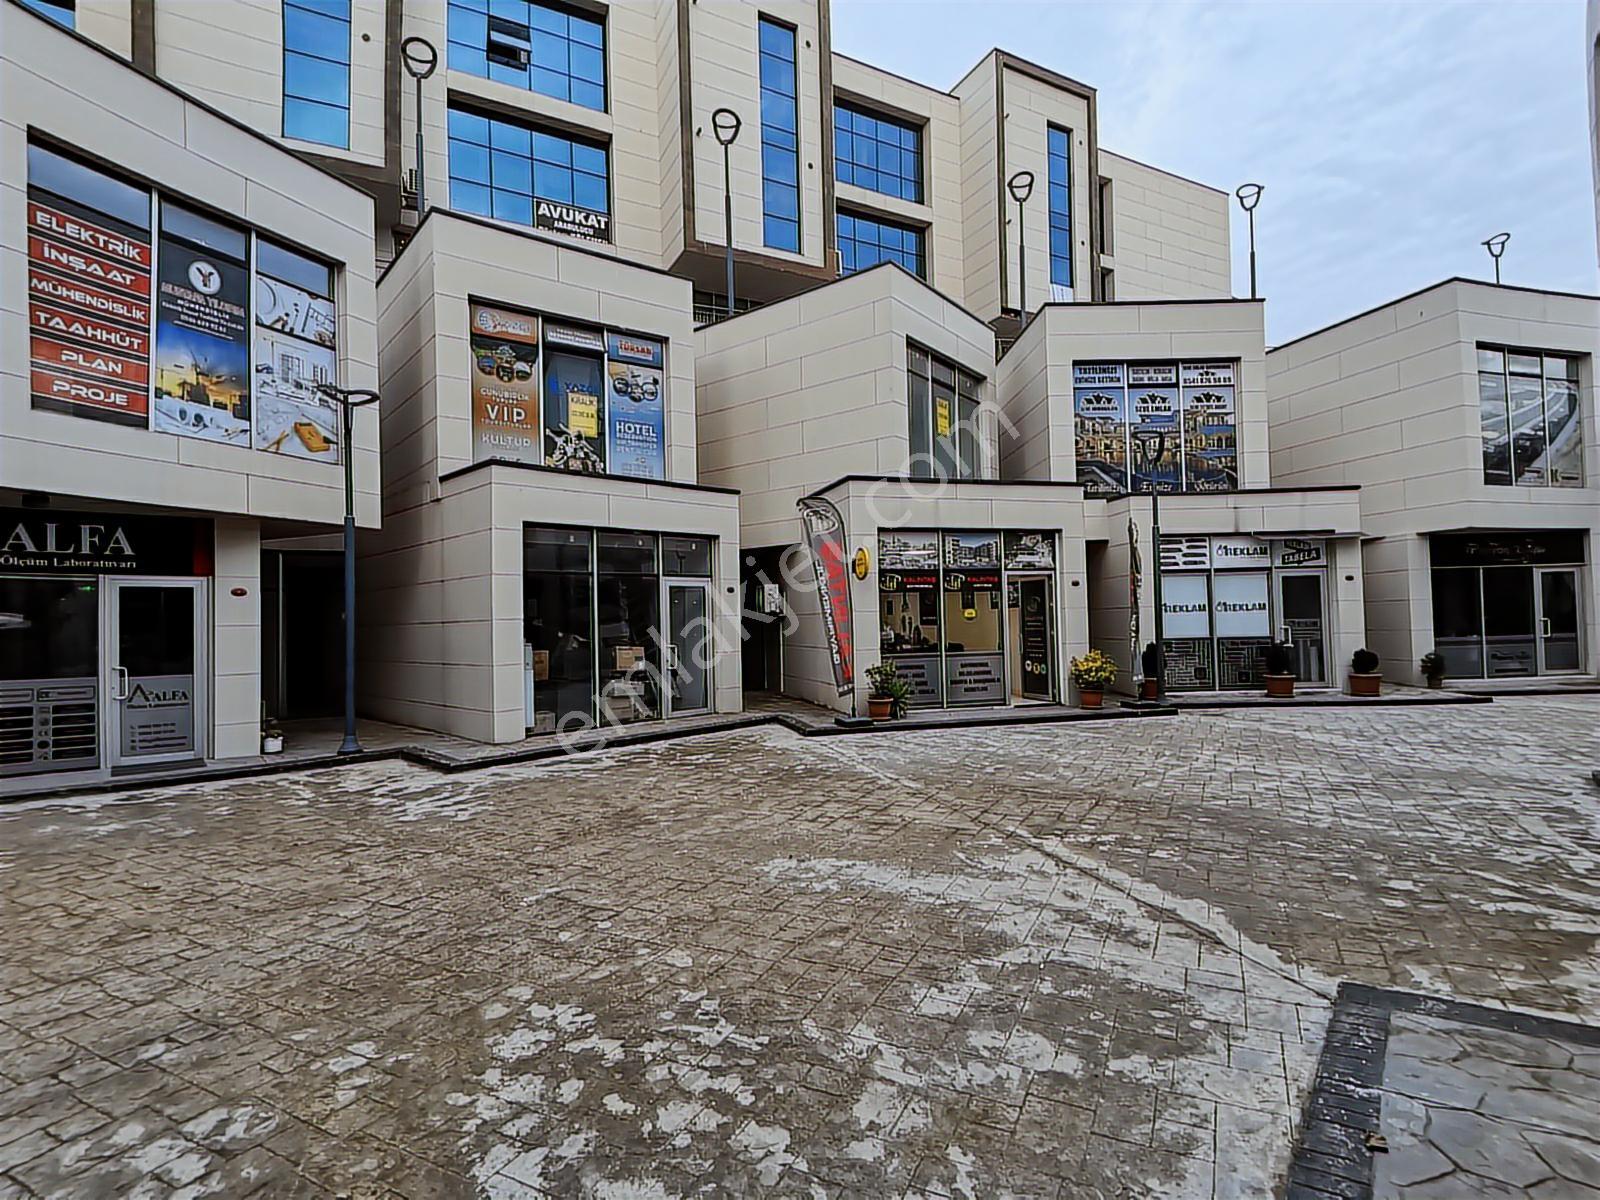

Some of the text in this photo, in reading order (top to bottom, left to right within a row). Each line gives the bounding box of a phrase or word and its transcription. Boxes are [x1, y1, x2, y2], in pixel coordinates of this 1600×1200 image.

[538, 203, 608, 229] AVUKAT
[36, 210, 143, 262] ELEKTRİK
[43, 243, 135, 285] İNŞAAT
[31, 276, 146, 321] MÜHENDİSLİK
[36, 311, 142, 351] TAAHHÜT
[61, 350, 123, 374] PLAN
[52, 380, 128, 406] PROJE
[485, 403, 526, 423] VIP
[616, 421, 657, 436] HOTEL
[2, 523, 136, 555] ALFA
[1284, 550, 1317, 562] TABELA
